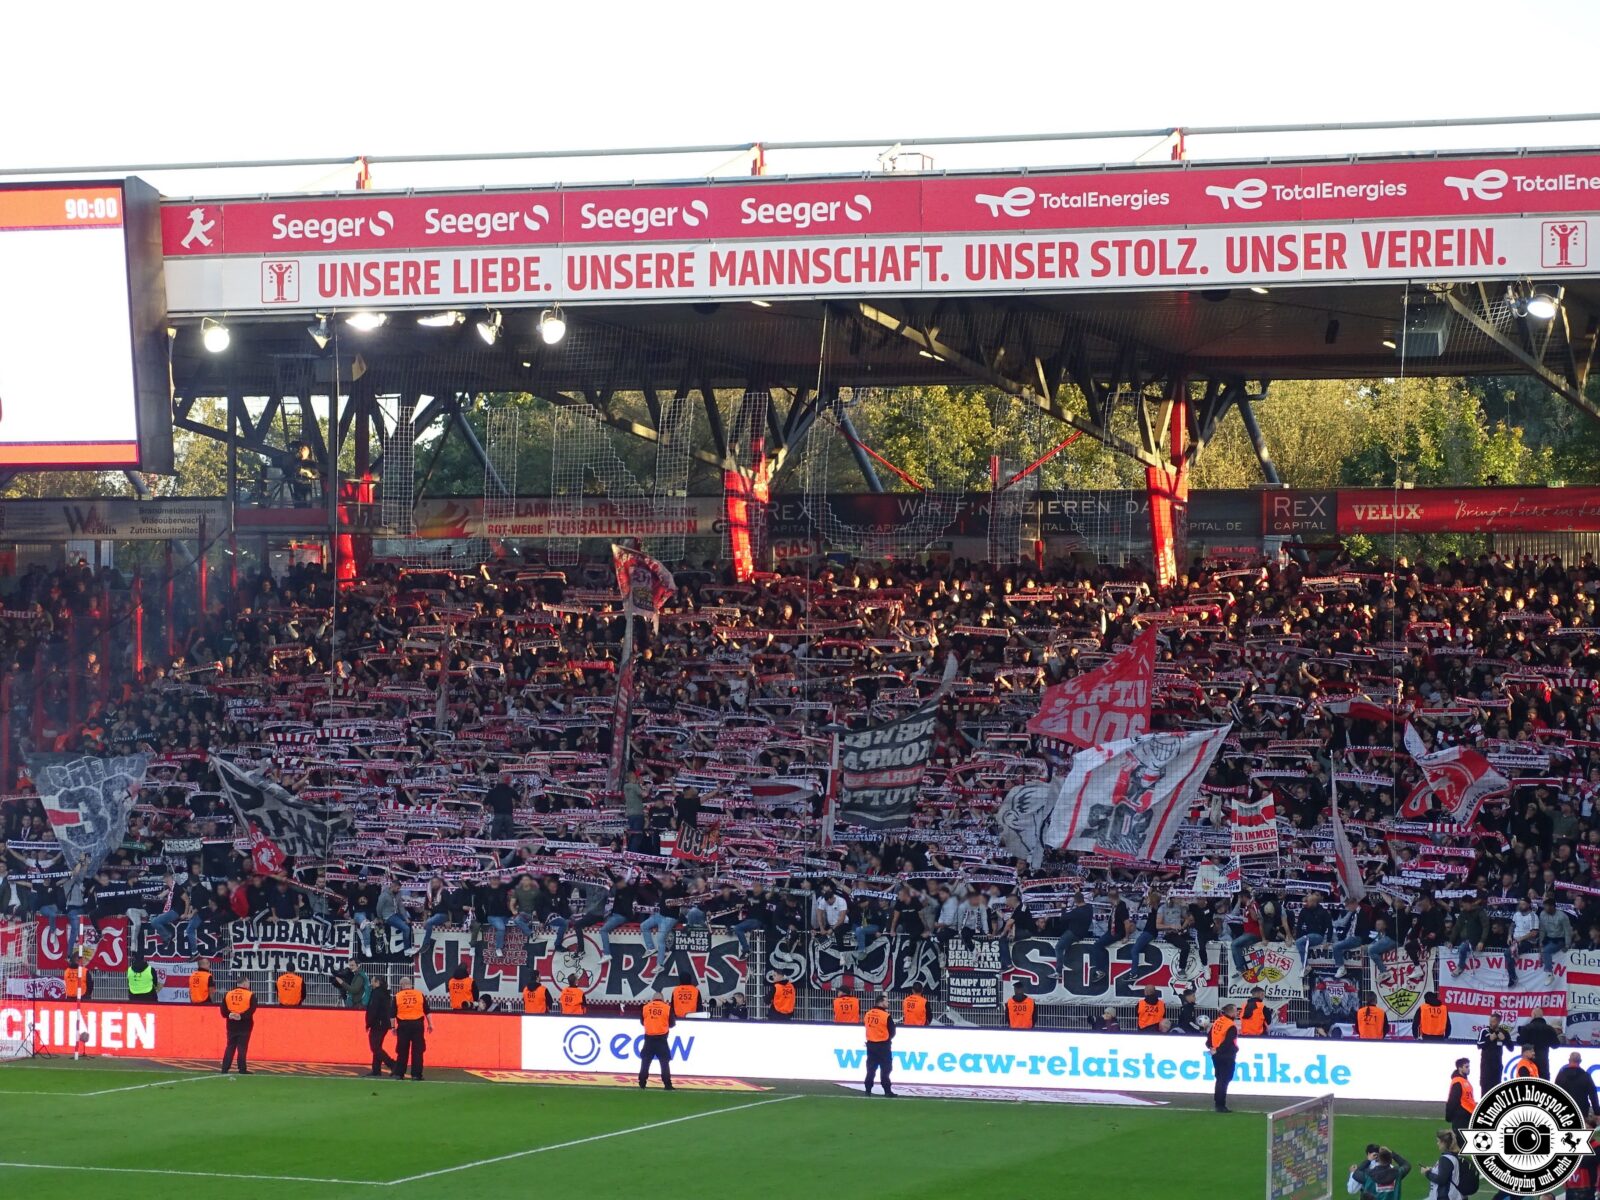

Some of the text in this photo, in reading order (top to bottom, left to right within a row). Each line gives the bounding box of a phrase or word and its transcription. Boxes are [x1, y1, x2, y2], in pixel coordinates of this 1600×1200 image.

[1039, 189, 1170, 211] TotalEnergies
[1271, 179, 1408, 203] TotalEnergies
[65, 197, 118, 220] 90:00
[580, 202, 680, 233] Seeger
[740, 197, 841, 228] Seeger
[272, 212, 366, 244] Seeger
[424, 207, 520, 238] Seeger
[317, 226, 1507, 298] UNSERE LIEBE. UNSERE MANNSCHAFT. UNSER STOLZ. UNSER VEREIN.
[897, 499, 942, 516] WIR
[1273, 496, 1328, 518] REX
[1352, 503, 1422, 521] VELUX
[1455, 500, 1507, 525] Bringt
[1273, 520, 1328, 531] CAPITAL
[675, 937, 709, 946] IMMER
[231, 951, 350, 974] STUTTGART
[949, 978, 997, 987] KAMPF UND
[949, 986, 997, 996] EINSATZ FÜR
[1013, 1004, 1028, 1013] 208
[1444, 990, 1565, 1010] STAUFER SCHWABEN
[0, 1007, 156, 1050] CHINEN
